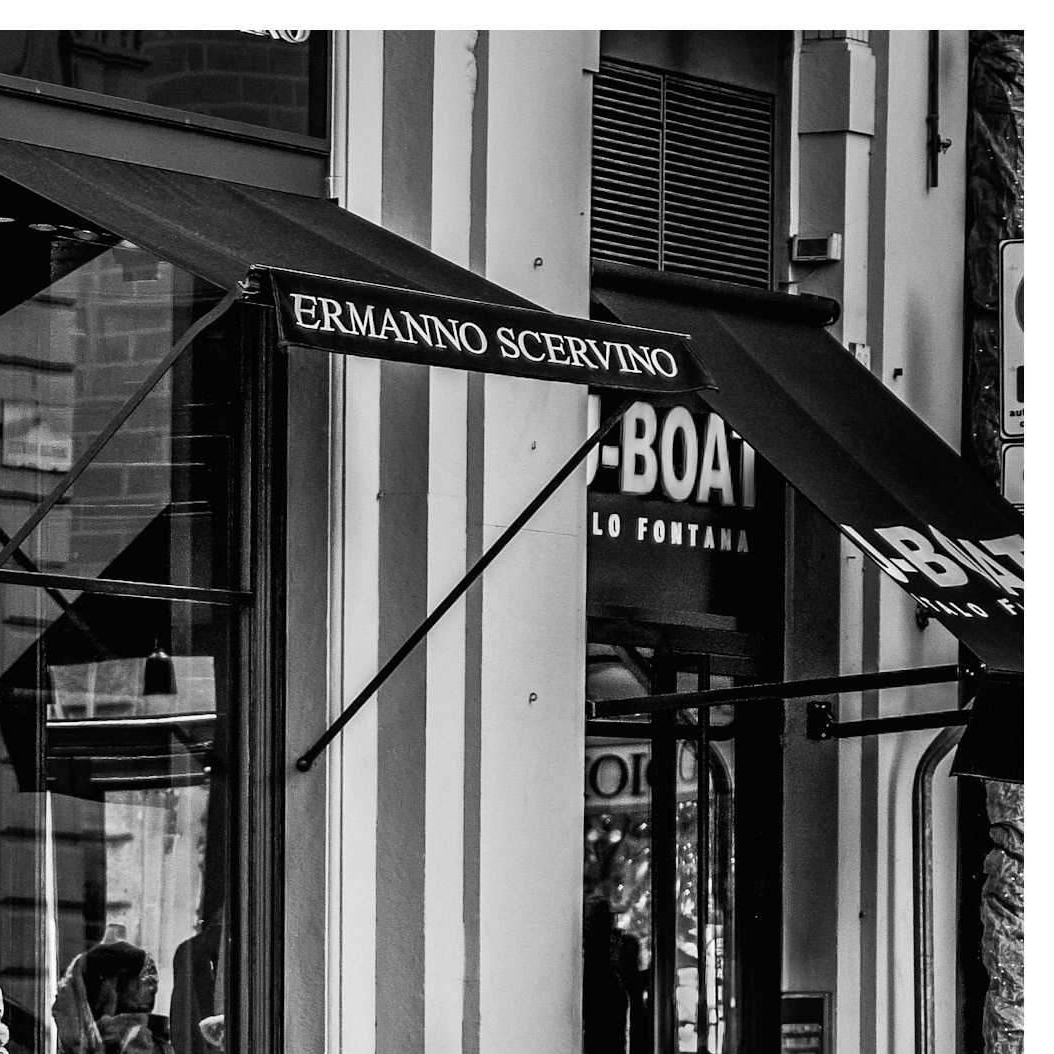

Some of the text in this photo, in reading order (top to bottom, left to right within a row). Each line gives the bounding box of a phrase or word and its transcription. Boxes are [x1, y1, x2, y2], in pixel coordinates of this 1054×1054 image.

[290, 293, 678, 378] ERMANNO SCERVINO
[637, 517, 749, 553] FONTANA
